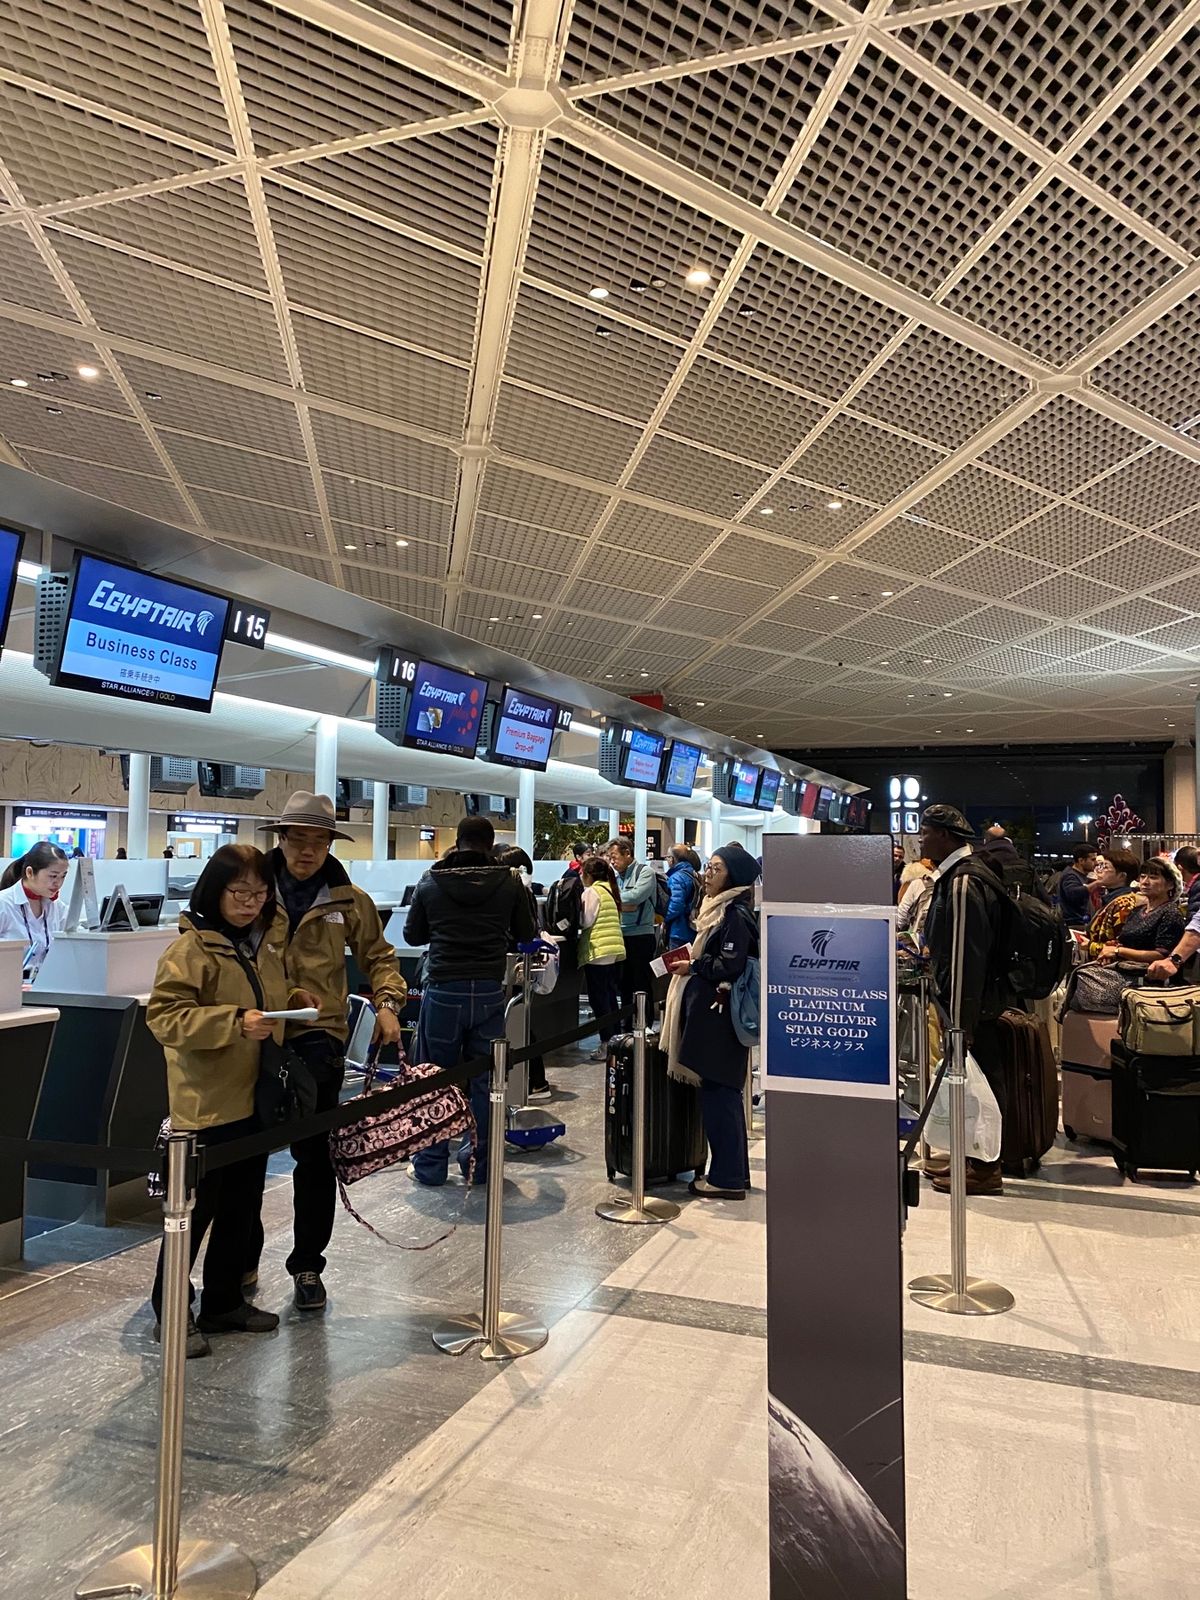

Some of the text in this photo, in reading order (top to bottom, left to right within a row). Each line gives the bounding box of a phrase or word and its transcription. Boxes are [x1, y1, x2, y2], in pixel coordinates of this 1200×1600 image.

[88, 580, 197, 632] EGYPTAIR
[246, 614, 266, 640] 15
[86, 632, 198, 671] Business Class
[401, 660, 416, 682] 16
[101, 681, 119, 691] STAR
[419, 681, 459, 705] EGYPTAIR
[507, 697, 545, 723] EGYPTAIR
[562, 711, 572, 727] 17
[788, 954, 861, 971] EGYPTAIR
[768, 984, 888, 1000] BUSINESS CLASS
[788, 998, 866, 1012] PLATINUM
[777, 1010, 878, 1027] GOLD/SILVER
[785, 1024, 869, 1039] STAR GOLD
[790, 1037, 865, 1051] ビジネスクラス
[179, 1220, 187, 1230] E
